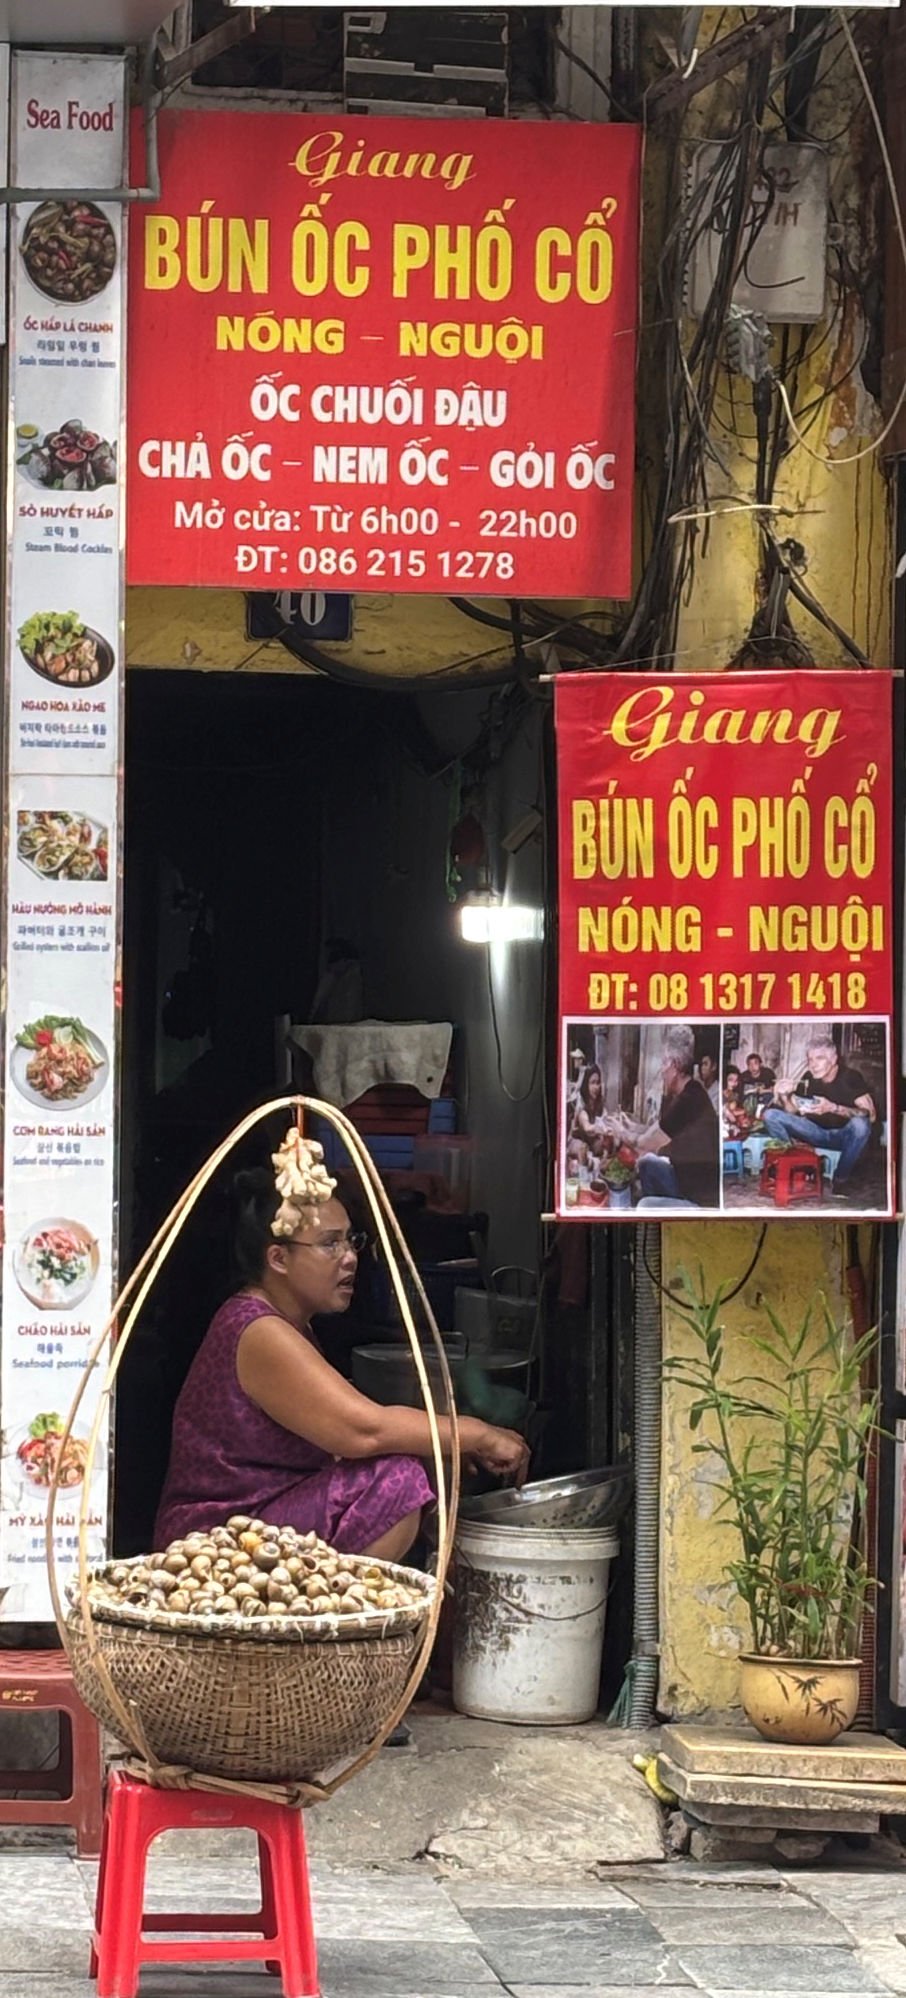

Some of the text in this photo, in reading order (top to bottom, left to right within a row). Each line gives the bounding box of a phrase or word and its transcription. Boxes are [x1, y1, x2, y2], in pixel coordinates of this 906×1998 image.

[27, 99, 114, 132] Sea Food
[288, 131, 477, 190] Giang
[144, 194, 617, 304] BÚN ỐC PHỐ CỔ
[23, 315, 113, 333] ỐC HẤP LÁ CHANH
[215, 311, 345, 354] NÓNG
[399, 317, 544, 364] NGUỘI
[250, 371, 507, 431] ỐC CHUỐI ĐẬU
[138, 431, 211, 480] CHẢ
[221, 430, 271, 482] ỐC
[313, 446, 388, 485] NEM
[399, 437, 449, 487] ỐC
[490, 443, 555, 489] GỎI
[566, 441, 616, 491] ỐC
[18, 502, 114, 519] SÒ HUYẾT HẤP
[174, 500, 225, 530] Mở
[233, 501, 301, 532] cửa:
[309, 505, 353, 533] Từ
[360, 507, 439, 535] 6h00
[479, 510, 577, 539] 22h00
[25, 542, 51, 552] Steam
[54, 543, 79, 553] Blood
[234, 545, 515, 580] ĐT: 086 215 1278
[273, 590, 326, 626] 40
[21, 700, 48, 711] NGAO
[50, 701, 69, 712] HOA
[602, 685, 847, 762] Giang
[572, 762, 879, 880] BÚN ỐC PHỐ CỔ
[85, 902, 112, 916] HÀNH
[578, 895, 884, 962] NÓNG - NGUỘI
[587, 971, 866, 1011] ĐT: 08 1317 1418
[67, 1122, 84, 1136] HẢI
[86, 1122, 105, 1137] SẢN
[50, 1321, 68, 1336] HẢI
[70, 1321, 91, 1336] SẢN
[12, 1358, 100, 1370] Seafood porride
[56, 1511, 75, 1526] HẢI
